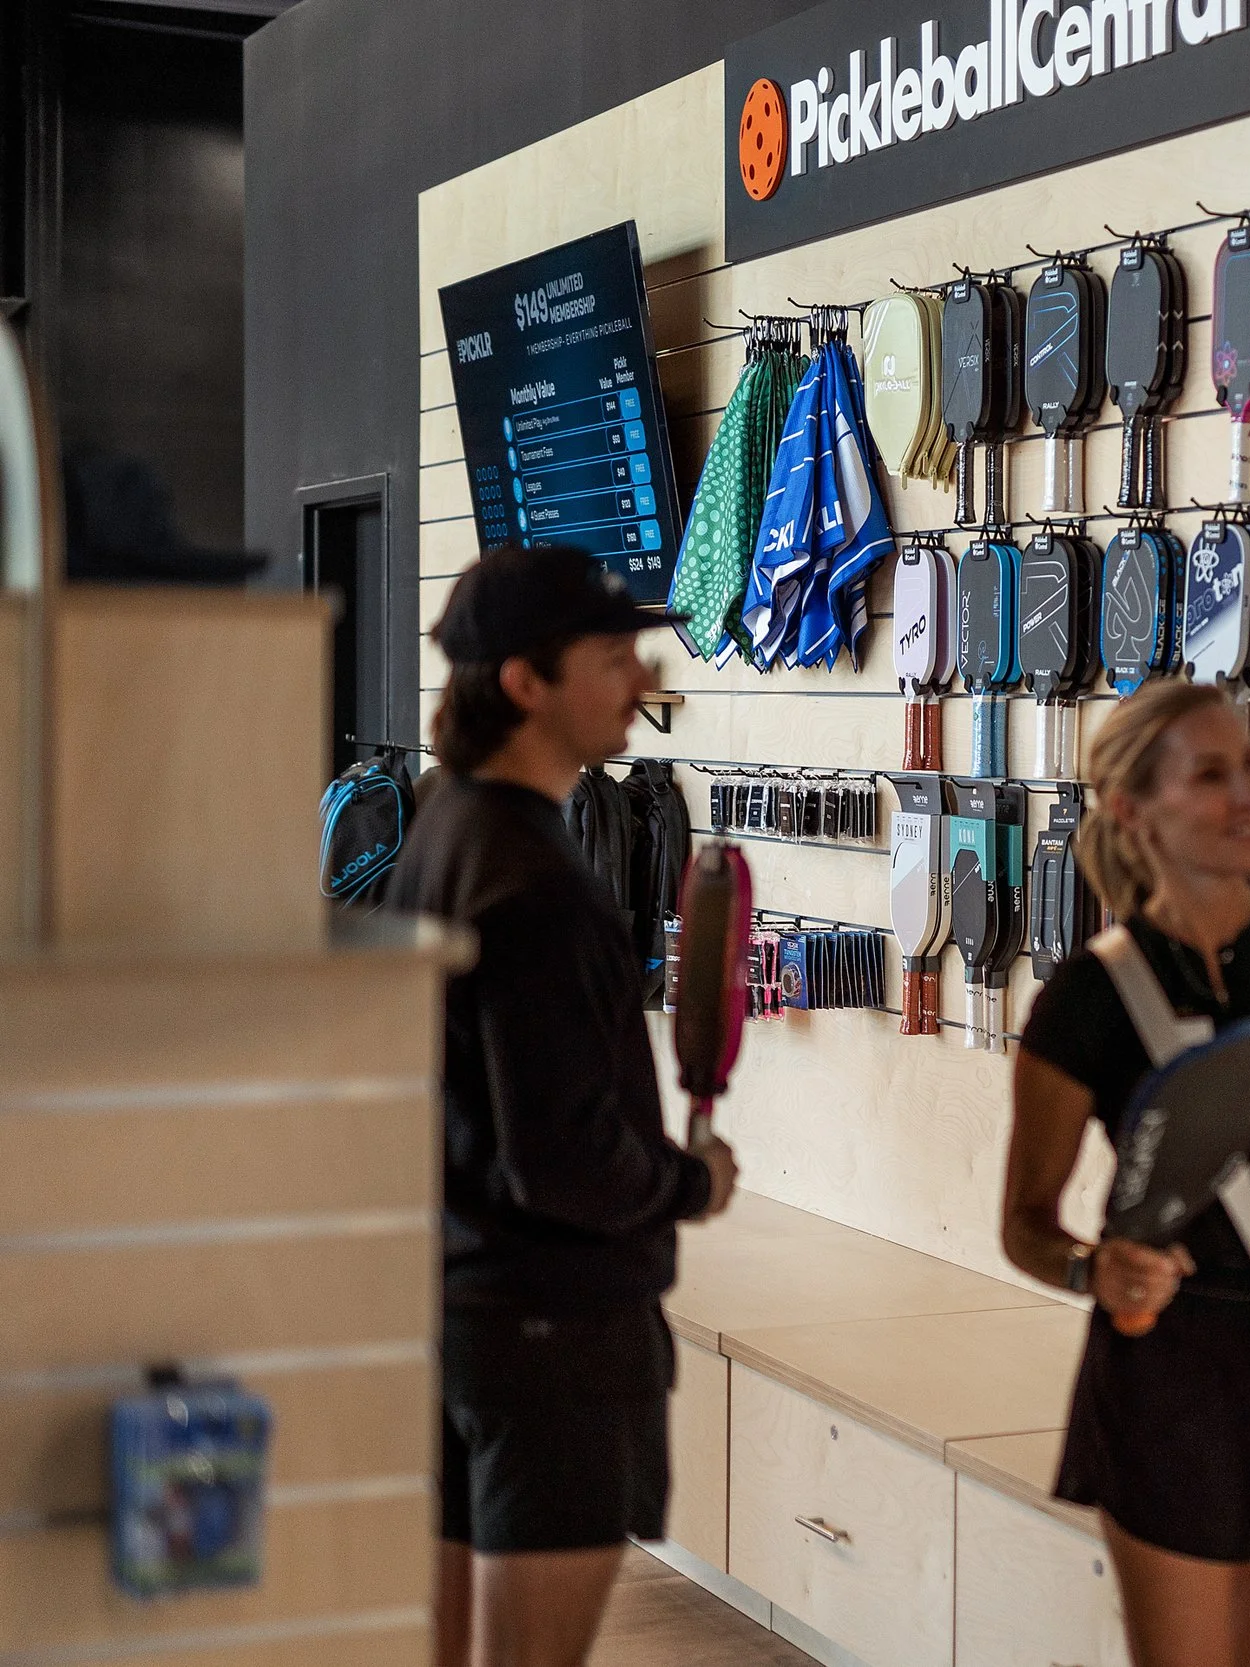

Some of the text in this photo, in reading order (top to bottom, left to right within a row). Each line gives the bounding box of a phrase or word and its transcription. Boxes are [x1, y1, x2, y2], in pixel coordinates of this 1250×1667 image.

[545, 272, 584, 300] UNLIMITED
[515, 288, 548, 331] $149
[550, 295, 595, 324] MEMBERSHIP
[566, 325, 598, 345] EVERYTHING
[599, 317, 632, 336] PICKLEBALL
[459, 331, 493, 363] PICKLR
[1029, 342, 1053, 367] CONTROL
[958, 353, 980, 369] VERSIX
[599, 377, 613, 389] Value
[616, 370, 634, 384] Member
[510, 380, 556, 405] Monthly Value
[625, 398, 635, 408] FREE
[1042, 401, 1060, 410] RALLY
[630, 430, 640, 439] FREE
[635, 463, 645, 473] FREE
[640, 496, 650, 506] FREE
[645, 530, 655, 539] FREE
[628, 558, 643, 572] $524
[647, 556, 662, 570] $149
[960, 590, 971, 670] VECTOR
[1022, 611, 1043, 634] POWER
[900, 614, 926, 656] TYRO
[896, 823, 923, 839] SYDNEY
[1041, 839, 1064, 847] BANTAM
